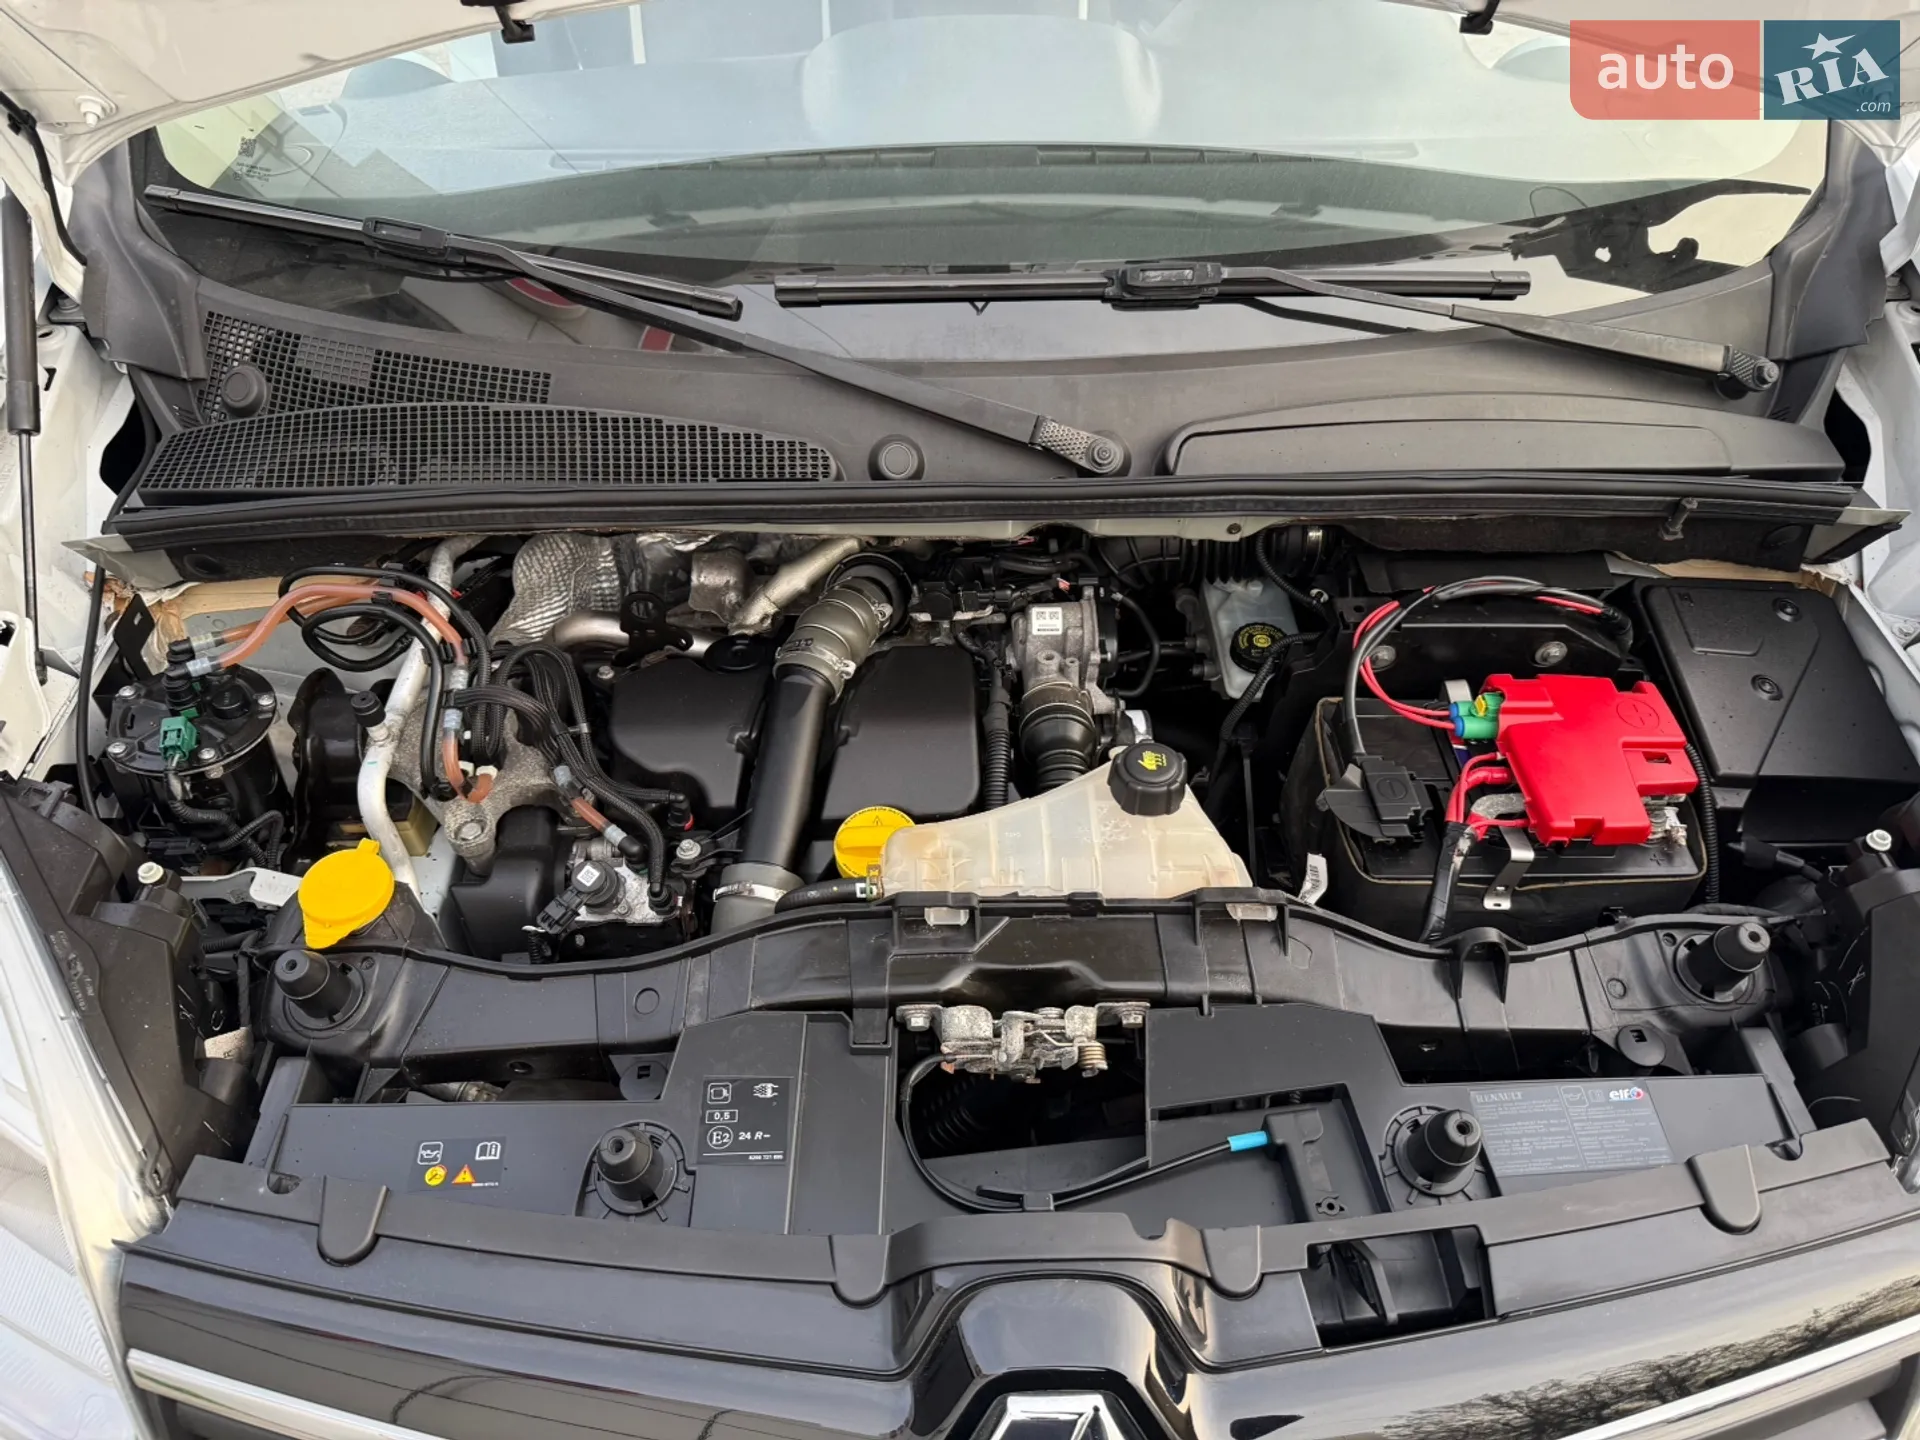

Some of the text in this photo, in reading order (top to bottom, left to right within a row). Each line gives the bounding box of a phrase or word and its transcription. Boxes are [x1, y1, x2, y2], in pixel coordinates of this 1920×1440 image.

[1476, 1091, 1523, 1103] RENAULT
[1609, 1088, 1630, 1100] elf
[714, 1112, 730, 1122] 0,5
[712, 1131, 730, 1145] E2
[738, 1131, 751, 1140] 24
